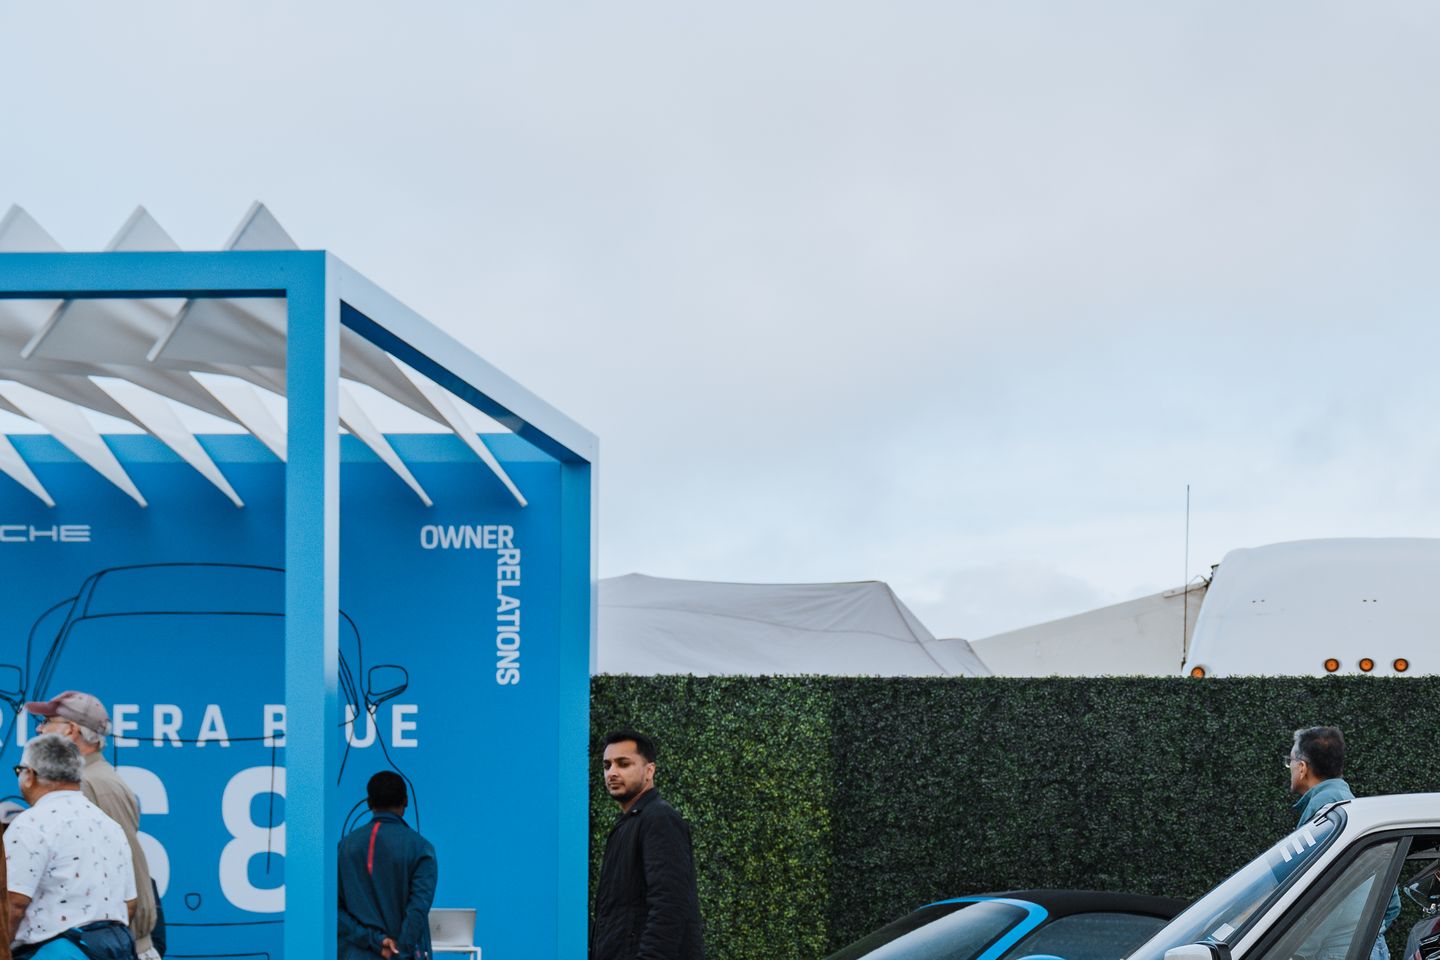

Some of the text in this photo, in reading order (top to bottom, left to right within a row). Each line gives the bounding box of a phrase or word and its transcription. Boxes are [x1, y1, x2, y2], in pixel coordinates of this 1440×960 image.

[420, 525, 514, 549] OWNER
[496, 548, 521, 685] RELATIONS
[264, 704, 418, 747] BUE
